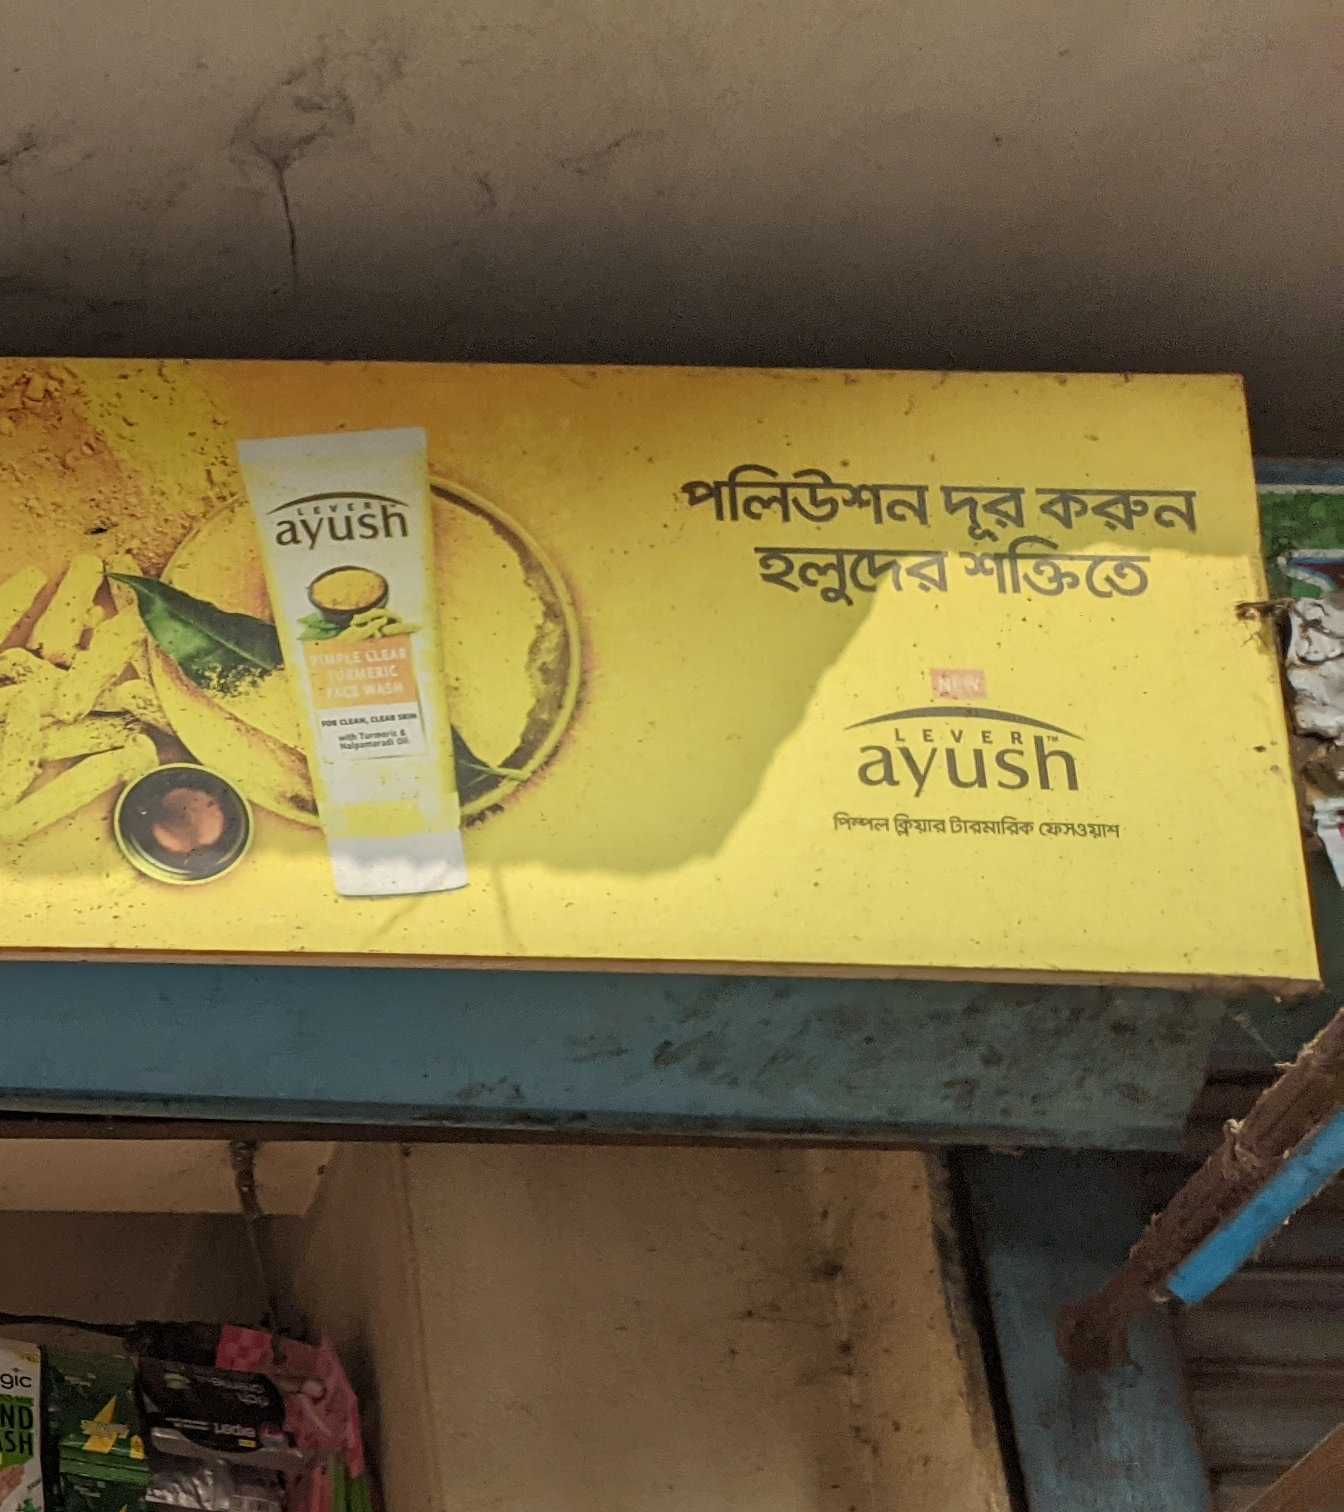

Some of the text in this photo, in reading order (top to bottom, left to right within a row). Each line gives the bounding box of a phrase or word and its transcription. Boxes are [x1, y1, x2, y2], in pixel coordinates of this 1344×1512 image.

[275, 505, 408, 550] ayush
[680, 464, 1196, 541] পলিউশন দূর করুন
[754, 530, 1150, 606] হলুদের শক্তিতে
[859, 735, 1079, 797] ayush
[895, 729, 1024, 744] LEVER
